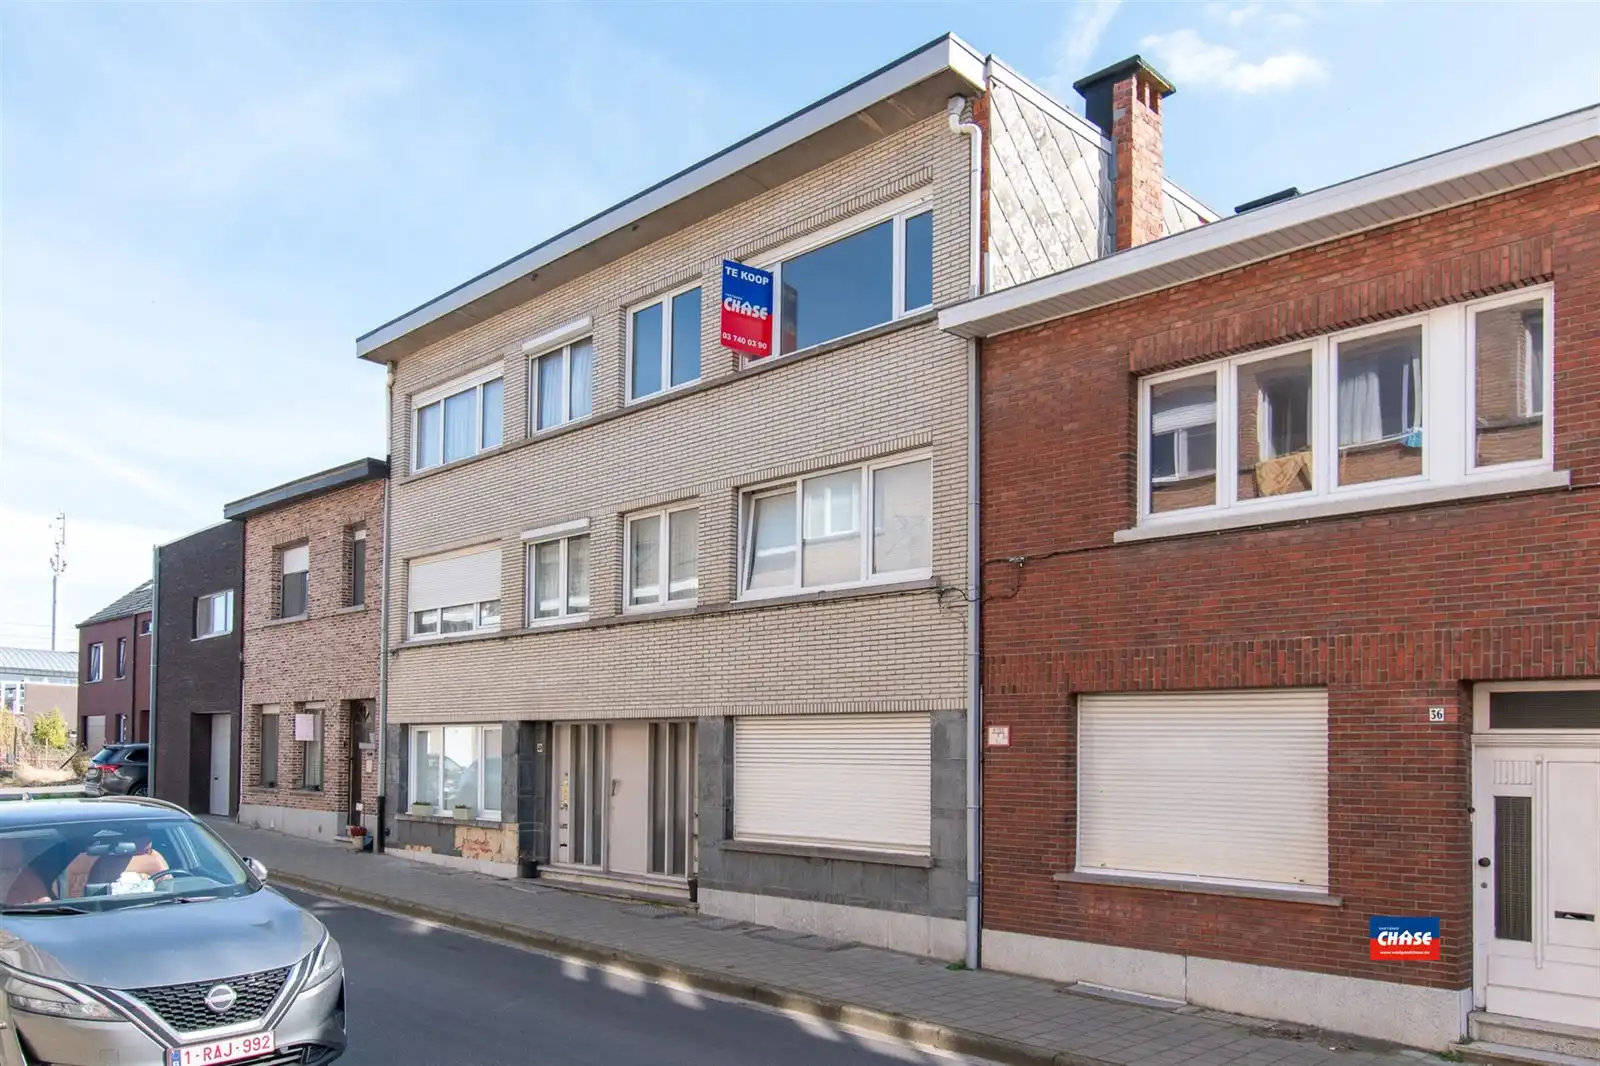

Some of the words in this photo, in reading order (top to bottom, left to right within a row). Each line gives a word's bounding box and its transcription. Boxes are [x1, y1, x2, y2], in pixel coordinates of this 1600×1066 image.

[725, 266, 738, 278] TE
[740, 270, 769, 285] KOOP
[723, 297, 768, 320] CHASE
[722, 332, 732, 341] 03
[733, 334, 746, 345] 740
[747, 338, 757, 348] 03
[1431, 709, 1443, 720] 36
[1377, 930, 1433, 946] CHASE
[184, 1035, 271, 1065] 1-RAJ-992
